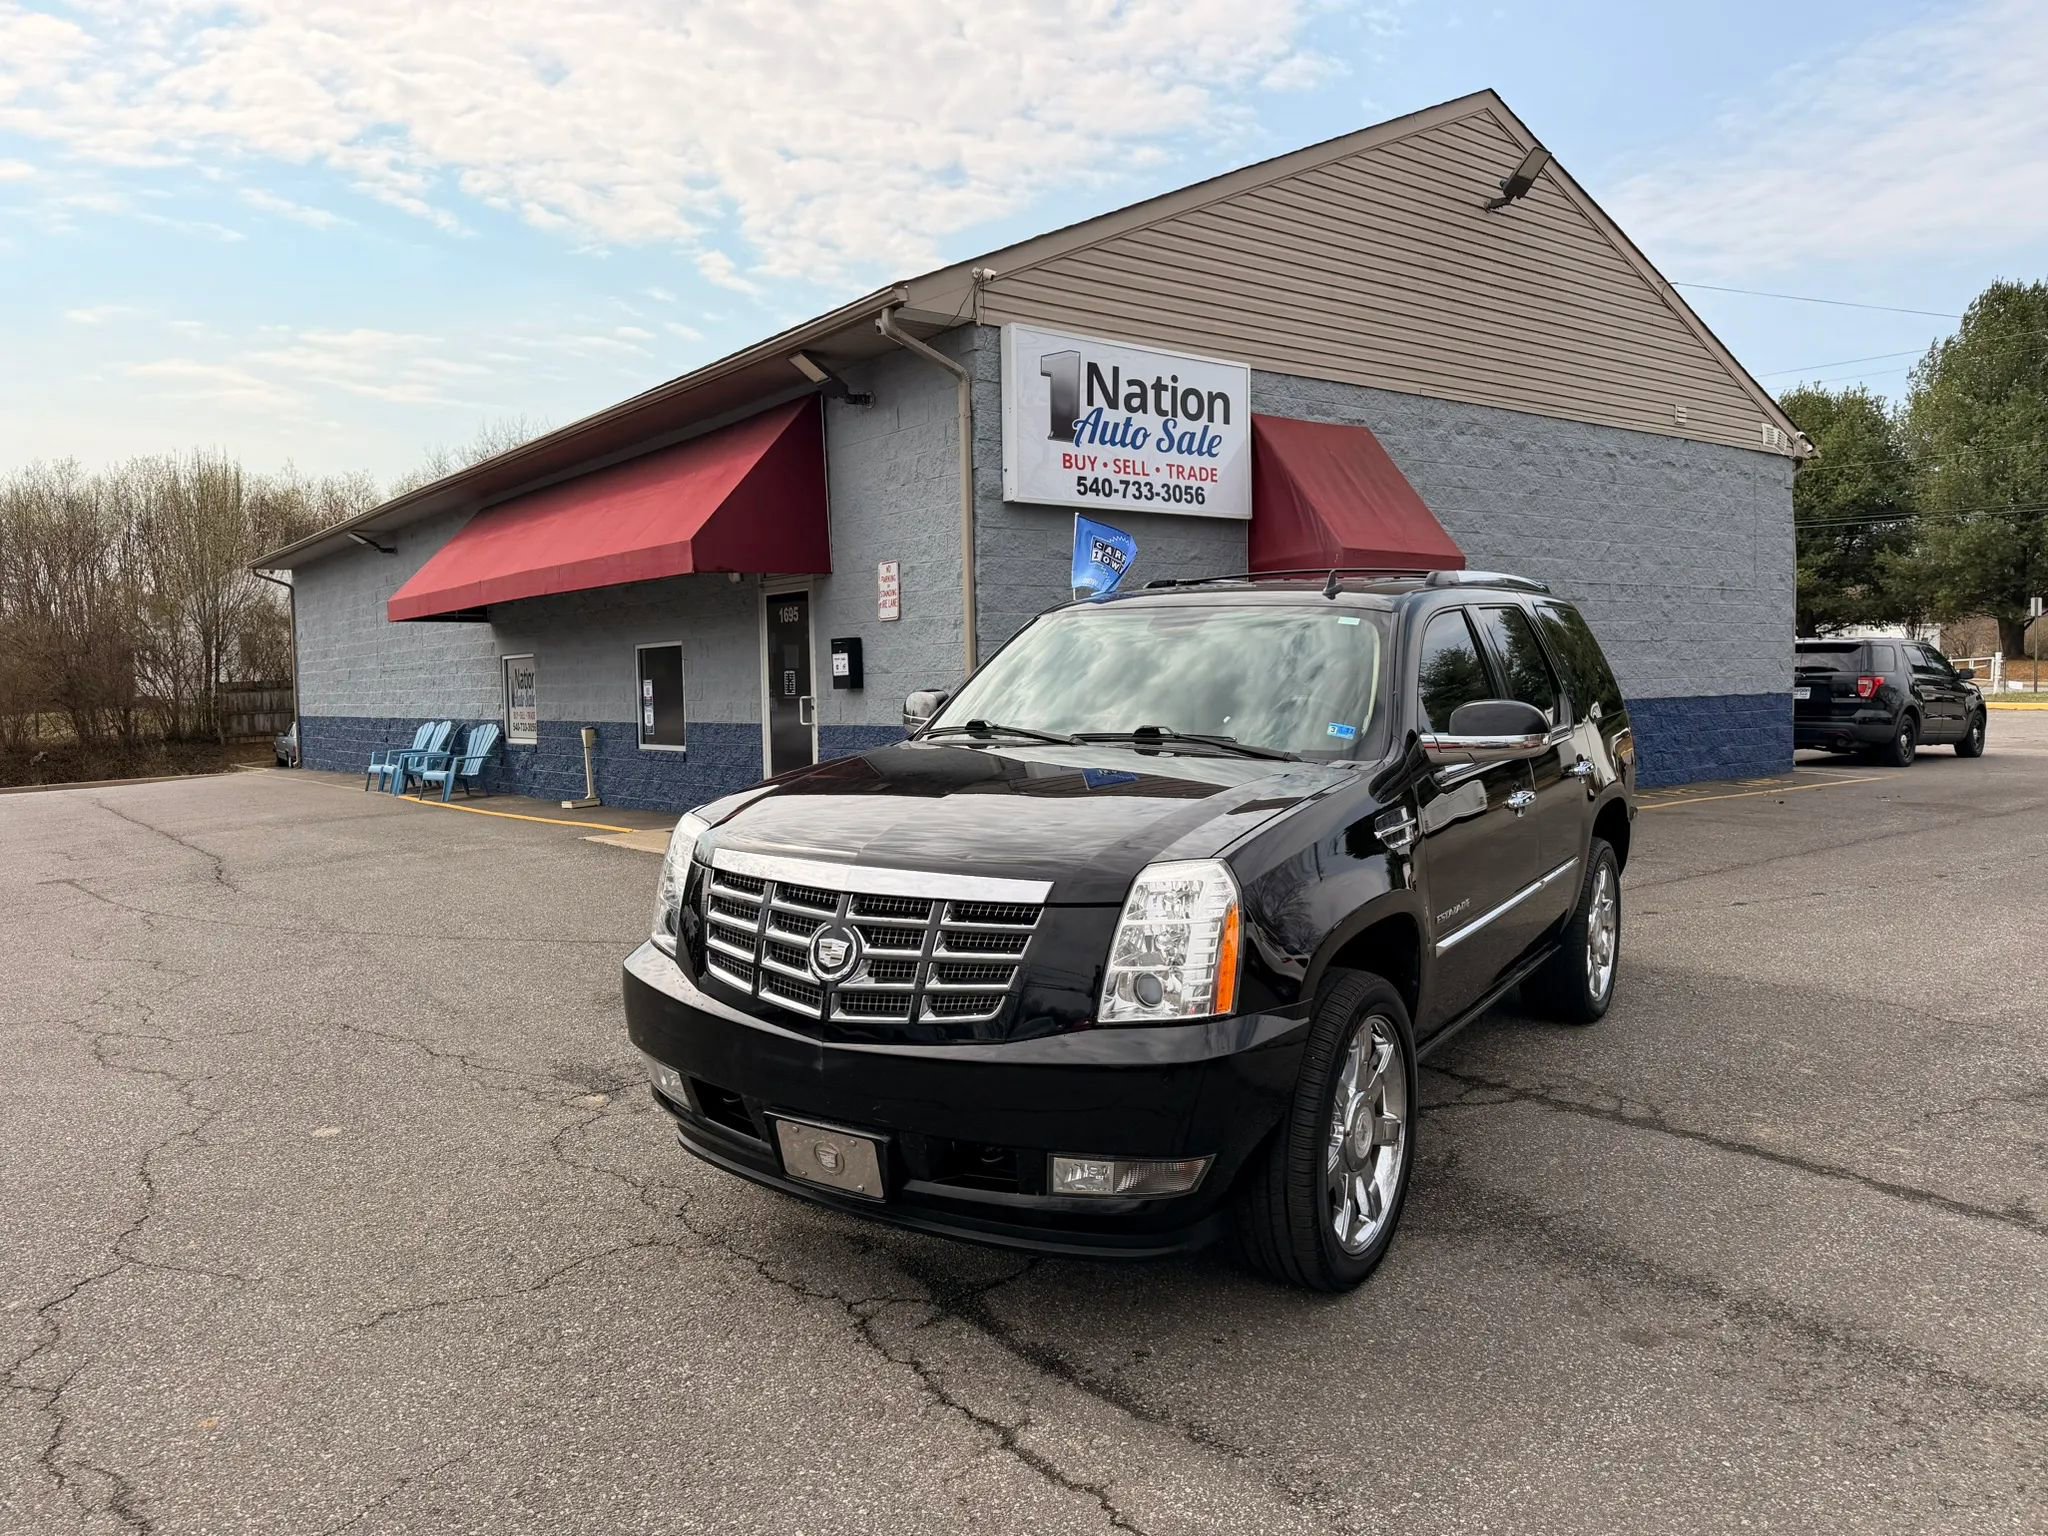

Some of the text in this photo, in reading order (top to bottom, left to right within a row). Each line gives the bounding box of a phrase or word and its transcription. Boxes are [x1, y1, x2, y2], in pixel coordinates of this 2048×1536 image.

[1041, 350, 1231, 443] 1 Nation
[1073, 407, 1223, 458] Auto Sale
[1062, 453, 1219, 483] BUY SELL TRADE
[1076, 475, 1206, 505] 540-733-3056
[779, 606, 799, 623] 1695
